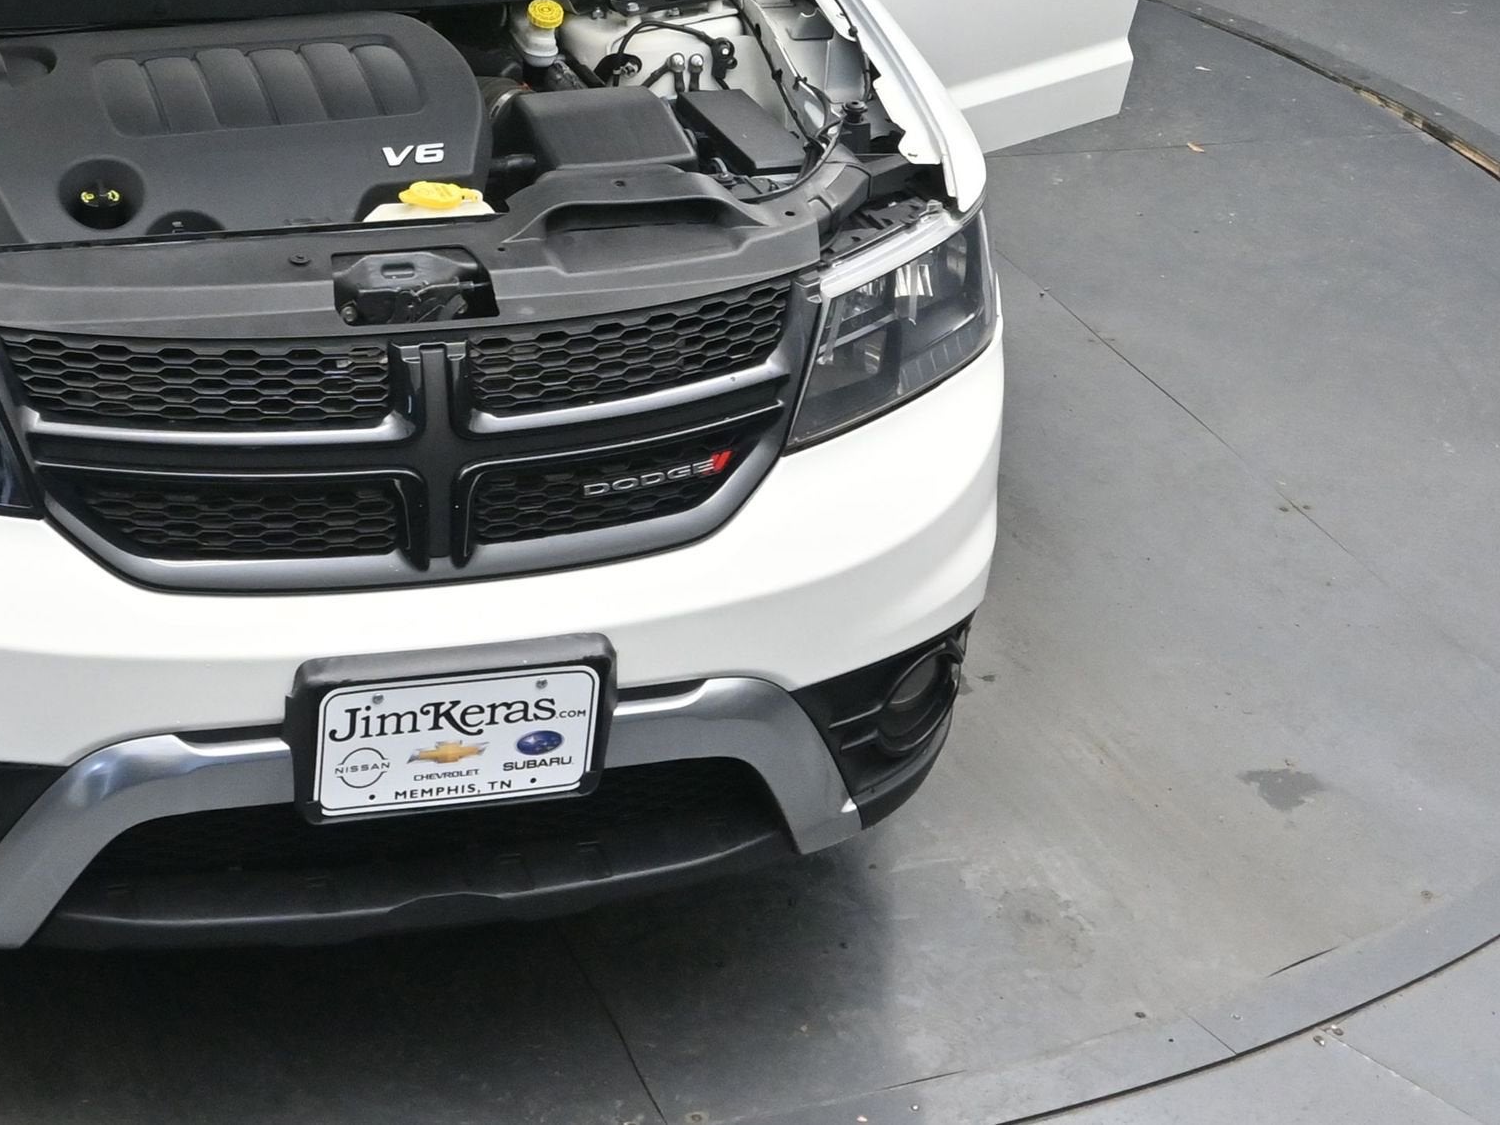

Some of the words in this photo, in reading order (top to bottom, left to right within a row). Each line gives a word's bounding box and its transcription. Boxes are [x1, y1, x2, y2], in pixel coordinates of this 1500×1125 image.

[381, 142, 445, 167] V6
[583, 458, 715, 496] DODGE
[334, 761, 391, 775] NISSAN
[502, 756, 573, 772] SUBARU
[413, 768, 480, 782] CHEVROLET
[394, 783, 482, 800] MEMPHIS,
[487, 778, 513, 790] TN
